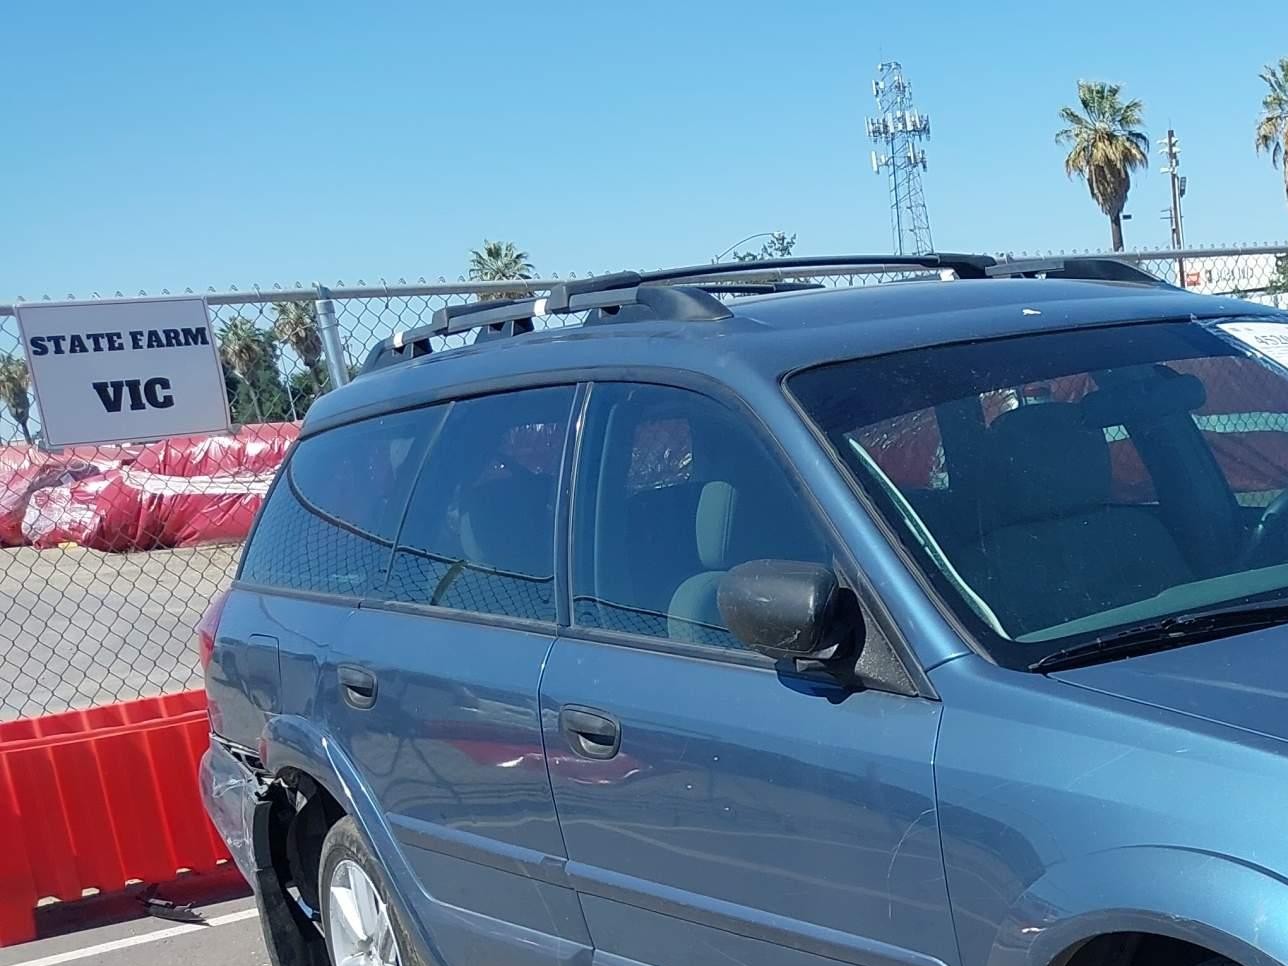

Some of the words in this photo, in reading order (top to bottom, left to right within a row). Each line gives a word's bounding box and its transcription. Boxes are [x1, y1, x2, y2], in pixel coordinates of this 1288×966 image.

[30, 331, 124, 356] STATE
[129, 326, 209, 350] FARM
[92, 376, 175, 413] VIC
